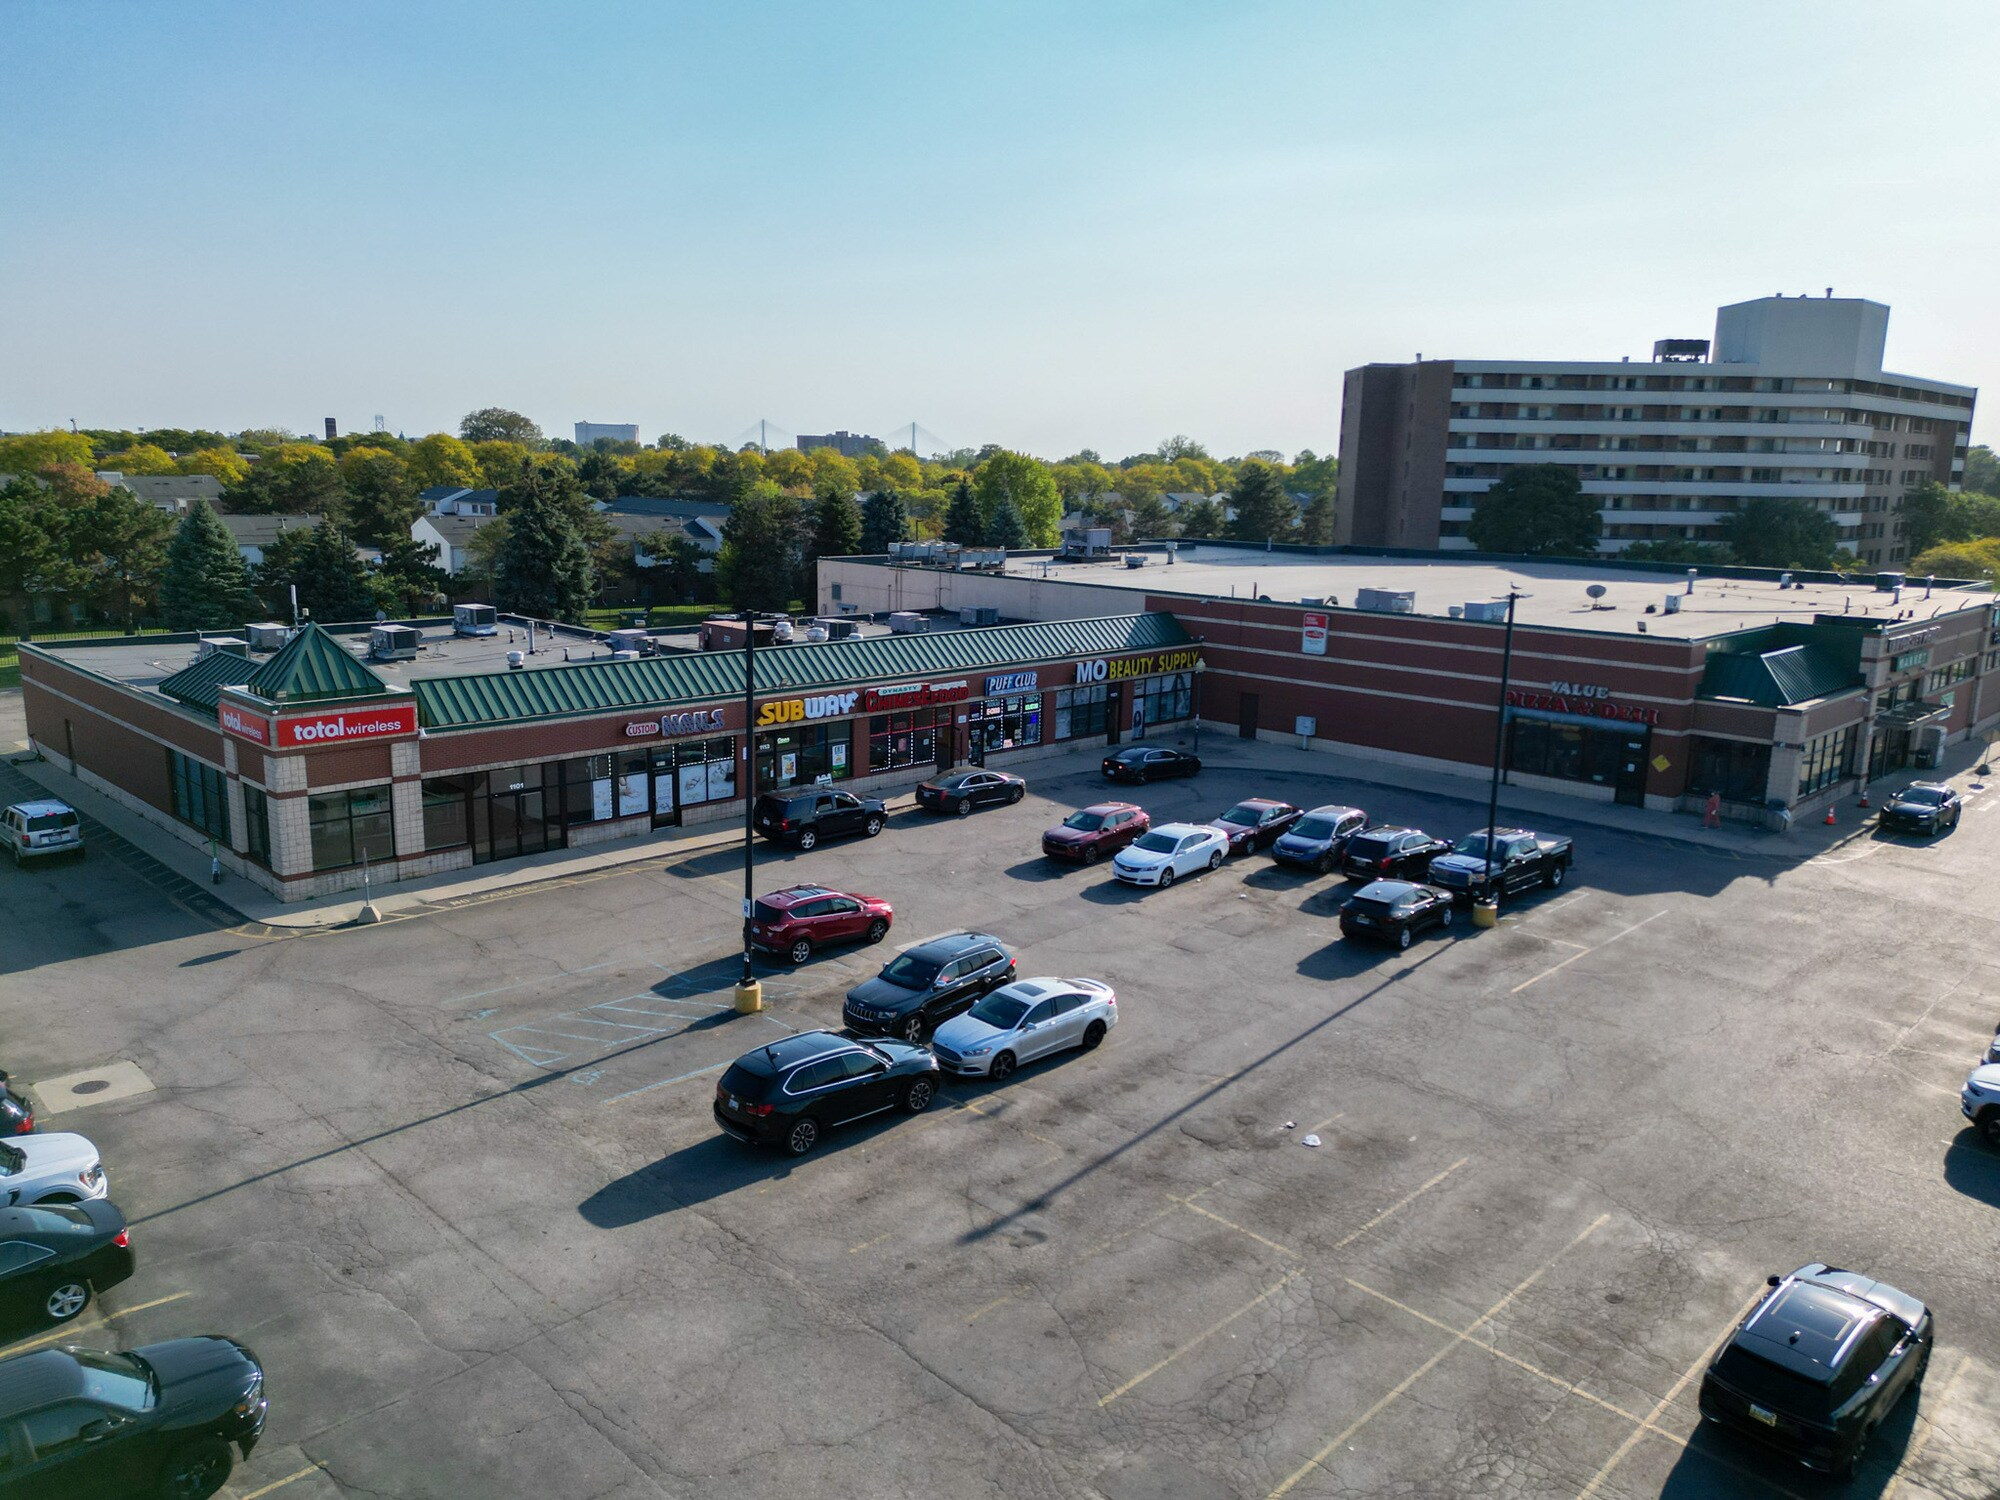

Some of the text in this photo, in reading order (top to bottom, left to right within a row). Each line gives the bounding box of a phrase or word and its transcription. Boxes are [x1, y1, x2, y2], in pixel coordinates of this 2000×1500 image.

[1076, 651, 1199, 683] MO BEAUTY SUPPLY
[882, 685, 918, 694] DYNASTY
[989, 676, 1014, 691] PUFF
[1014, 673, 1037, 687] CLUB
[1551, 681, 1609, 699] VALUE
[757, 691, 859, 726] SUBWAY
[866, 684, 930, 712] CHINESE
[931, 686, 969, 705] FOOD
[1506, 690, 1659, 724] PIZZA & DELI
[223, 711, 241, 731] total
[294, 717, 401, 741] total wireless
[628, 709, 724, 736] CUSTOM NAILS
